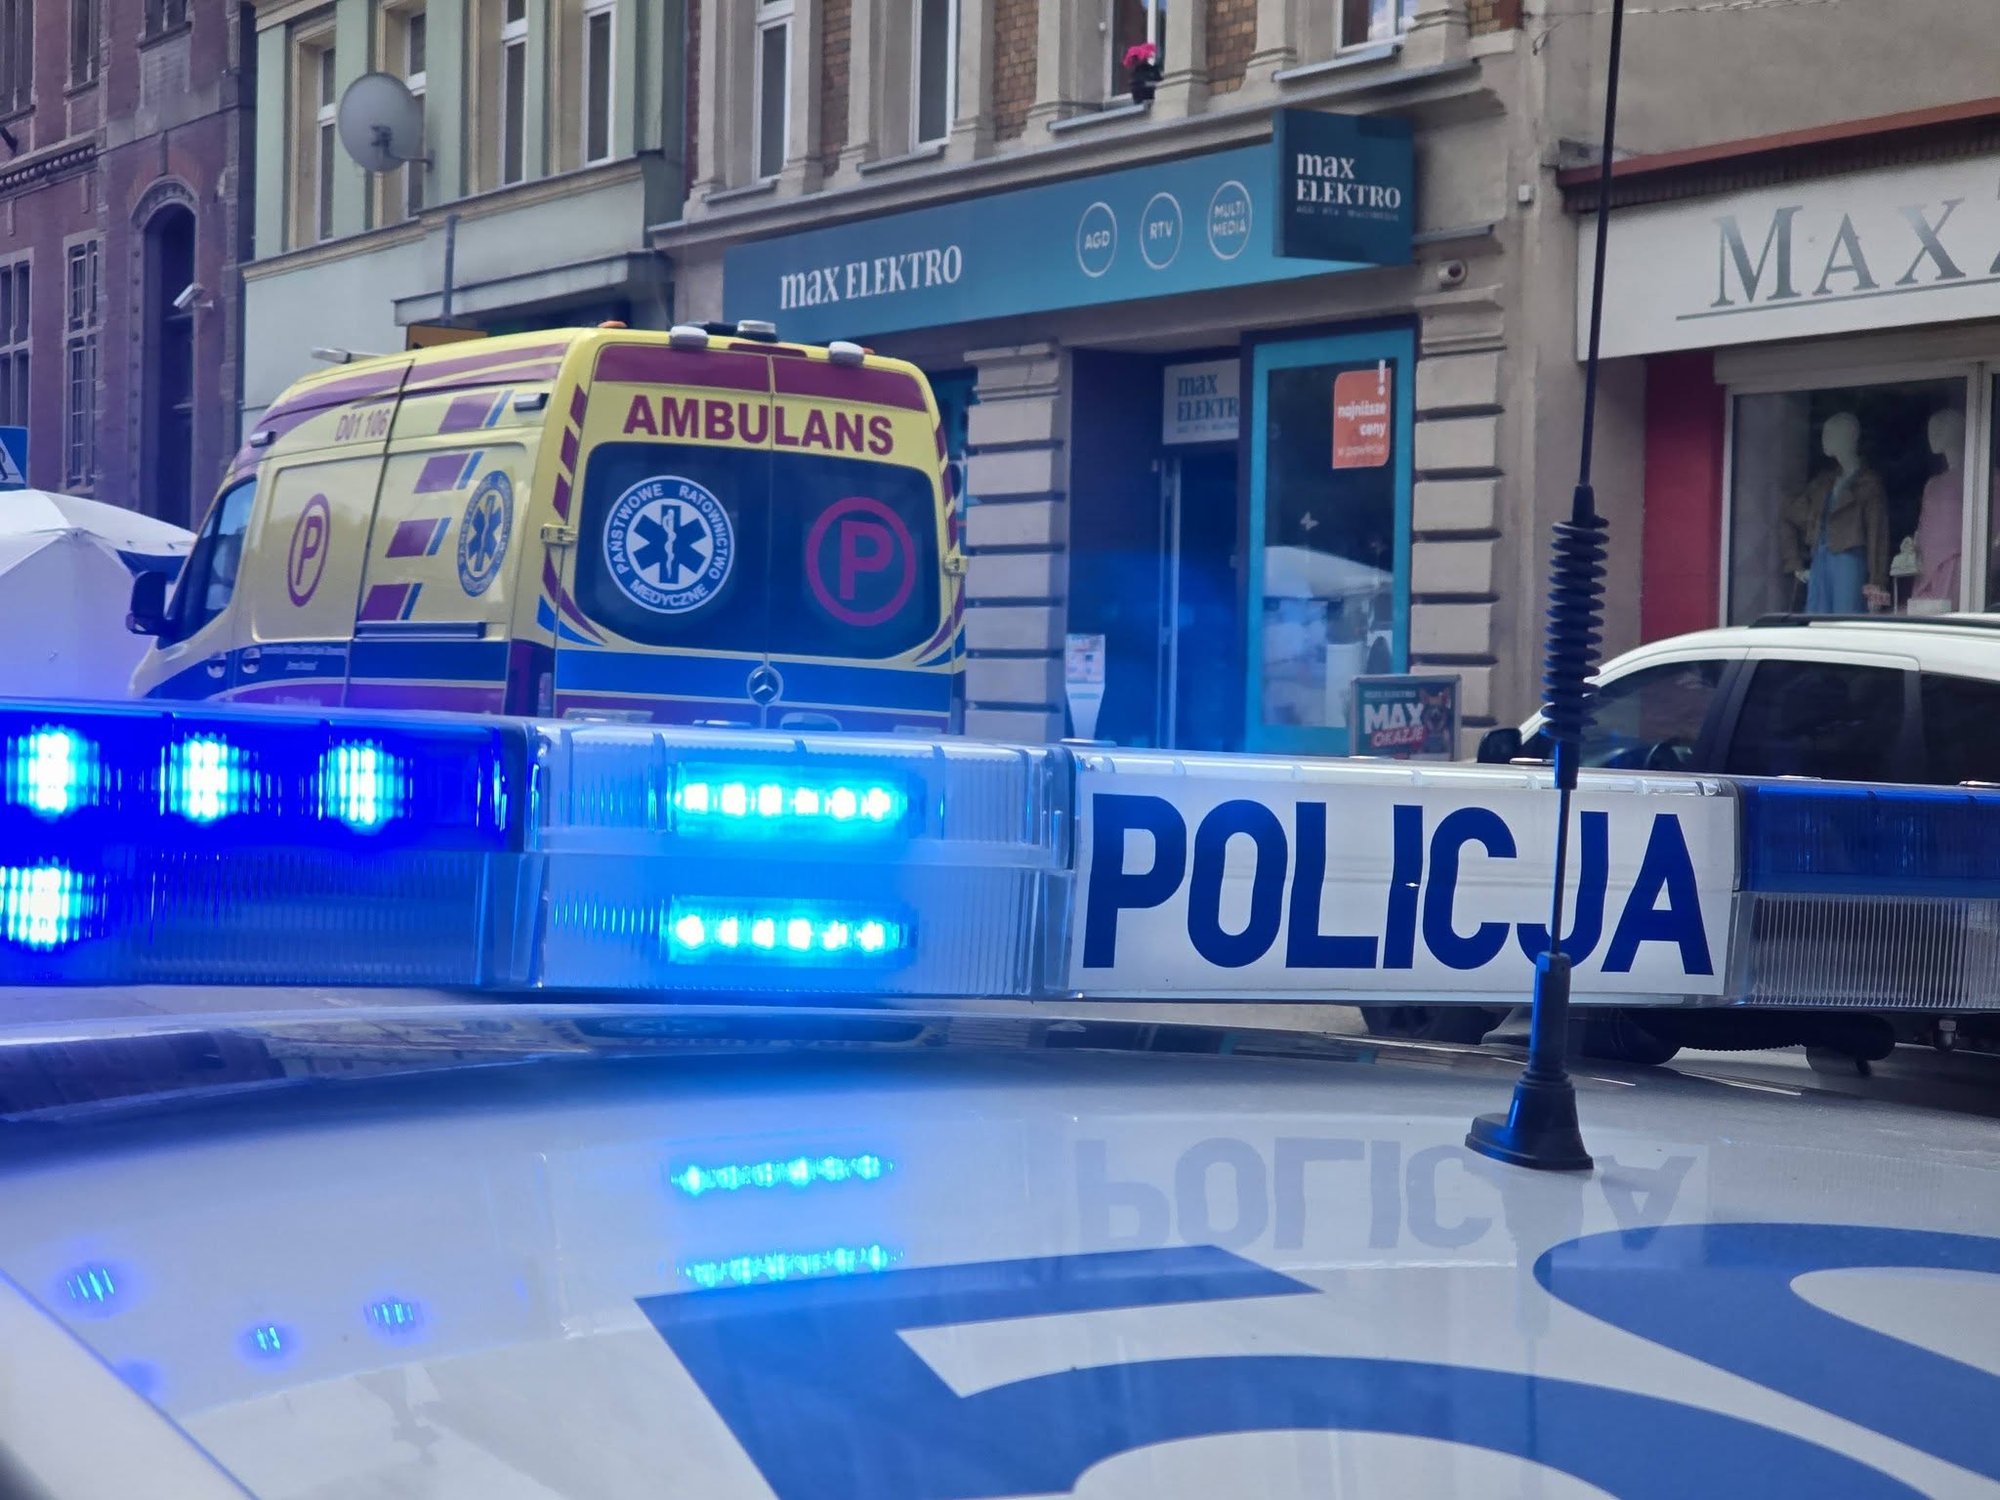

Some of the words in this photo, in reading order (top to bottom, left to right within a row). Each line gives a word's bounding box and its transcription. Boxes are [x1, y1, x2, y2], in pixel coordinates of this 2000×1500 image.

[1297, 153, 1355, 179] max
[1297, 179, 1401, 209] ELEKTRO
[1214, 201, 1246, 218] MULTI
[1084, 230, 1110, 250] AGD
[1150, 220, 1174, 240] RTV
[1213, 218, 1247, 236] MEDIA
[780, 266, 840, 310] max
[845, 245, 962, 299] ELEKTRO
[623, 394, 894, 456] AMBULANS
[609, 484, 664, 575] PAŃSTWOWE
[679, 485, 728, 580] RATOWNICTWO
[840, 520, 893, 600] P
[630, 579, 709, 606] MEDYCZNE
[1364, 703, 1424, 734] MAX
[1083, 793, 1714, 975] POLICJA
